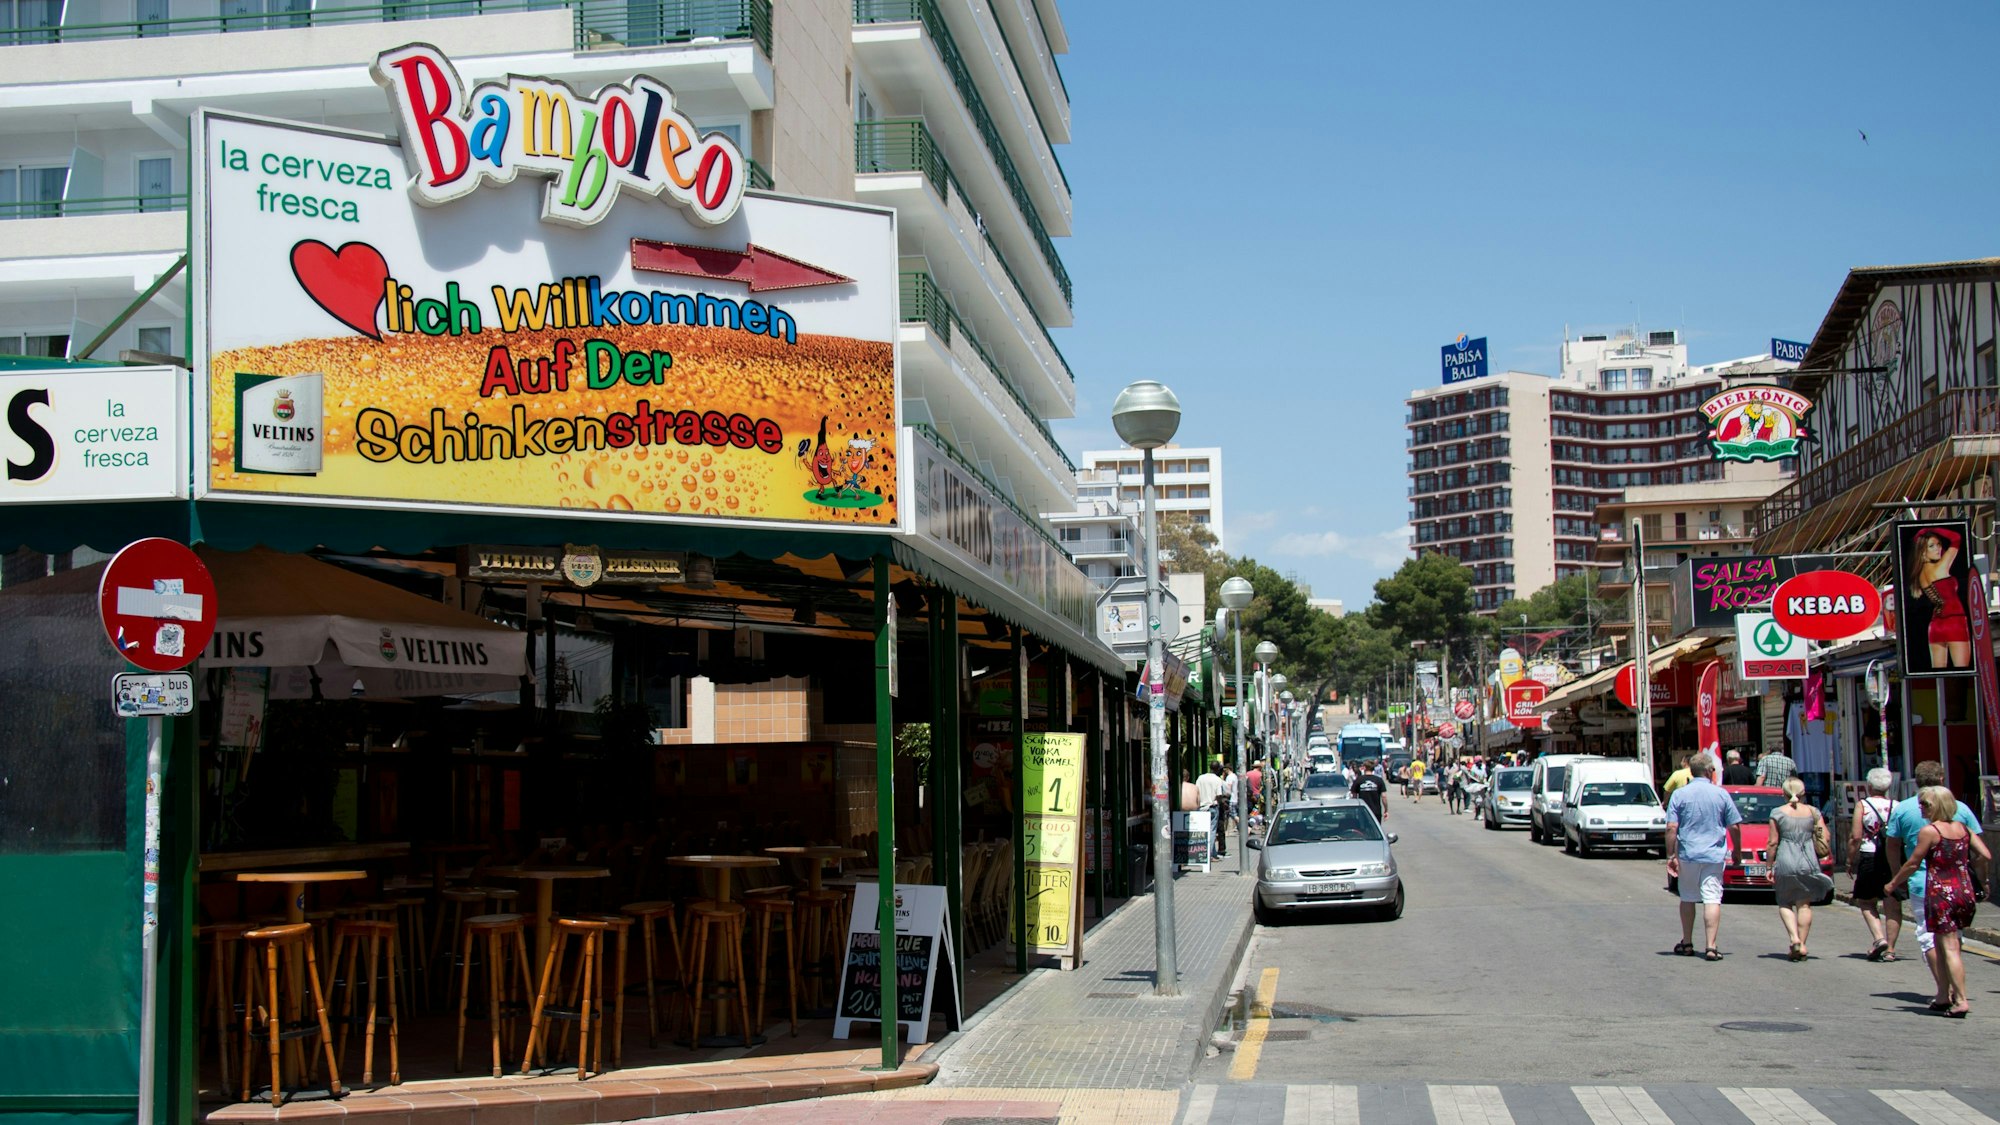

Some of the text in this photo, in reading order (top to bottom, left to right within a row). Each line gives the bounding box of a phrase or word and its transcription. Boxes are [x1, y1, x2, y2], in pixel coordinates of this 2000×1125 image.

[391, 54, 733, 210] Bamboleo
[221, 139, 392, 190] la cerveza
[257, 183, 360, 223] fresca
[383, 276, 797, 344] lich Willkommen
[479, 339, 672, 397] Auf Der
[1444, 348, 1483, 368] PABISA
[1451, 364, 1477, 381] BALI
[107, 399, 125, 417] la
[1706, 388, 1805, 416] BIERKÖNIG
[6, 387, 55, 482] S
[74, 425, 158, 443] cerveza
[252, 423, 315, 442] VELTINS
[355, 400, 783, 464] Schinkenstrasse
[84, 449, 149, 468] fresca
[943, 467, 993, 567] VELTINS
[478, 553, 556, 570] VELTINS
[607, 557, 681, 573] PILSENER
[1694, 557, 1778, 590] SALSA
[1710, 582, 1780, 613] ROSA
[1787, 594, 1867, 616] KEBAB
[401, 636, 490, 666] VELTINS
[1747, 662, 1805, 674] SPAR
[168, 678, 189, 690] bus
[1514, 707, 1533, 715] KÖN
[1031, 874, 1069, 888] LITER
[1750, 867, 1766, 876] 519
[851, 933, 880, 949] HEUT
[854, 970, 922, 988] HOLND
[848, 989, 875, 1014] 20
